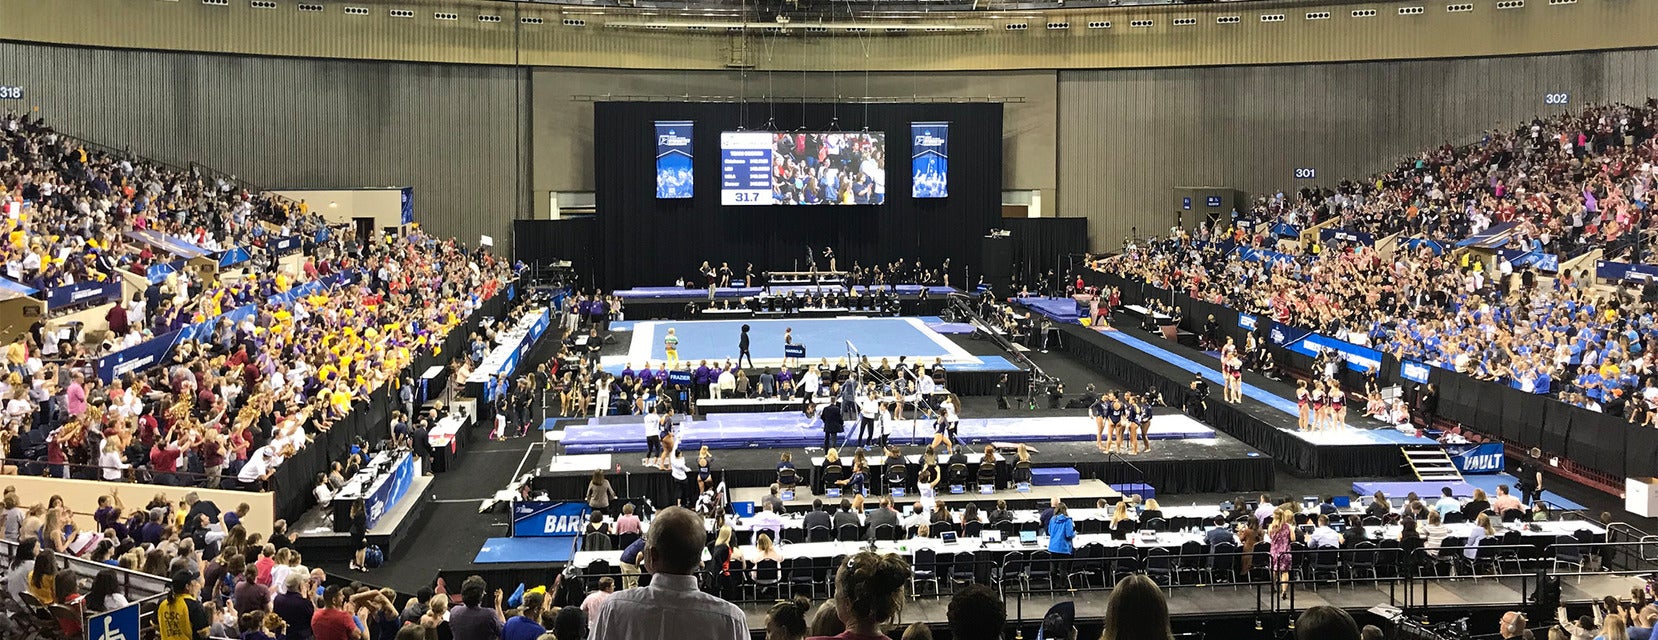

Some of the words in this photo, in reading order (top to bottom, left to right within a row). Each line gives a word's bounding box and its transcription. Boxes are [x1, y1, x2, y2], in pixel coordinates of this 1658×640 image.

[0, 86, 20, 98] 318
[1546, 93, 1568, 104] 302
[1296, 168, 1315, 178] 301
[735, 192, 760, 202] 31.7
[1463, 453, 1503, 470] VAULT
